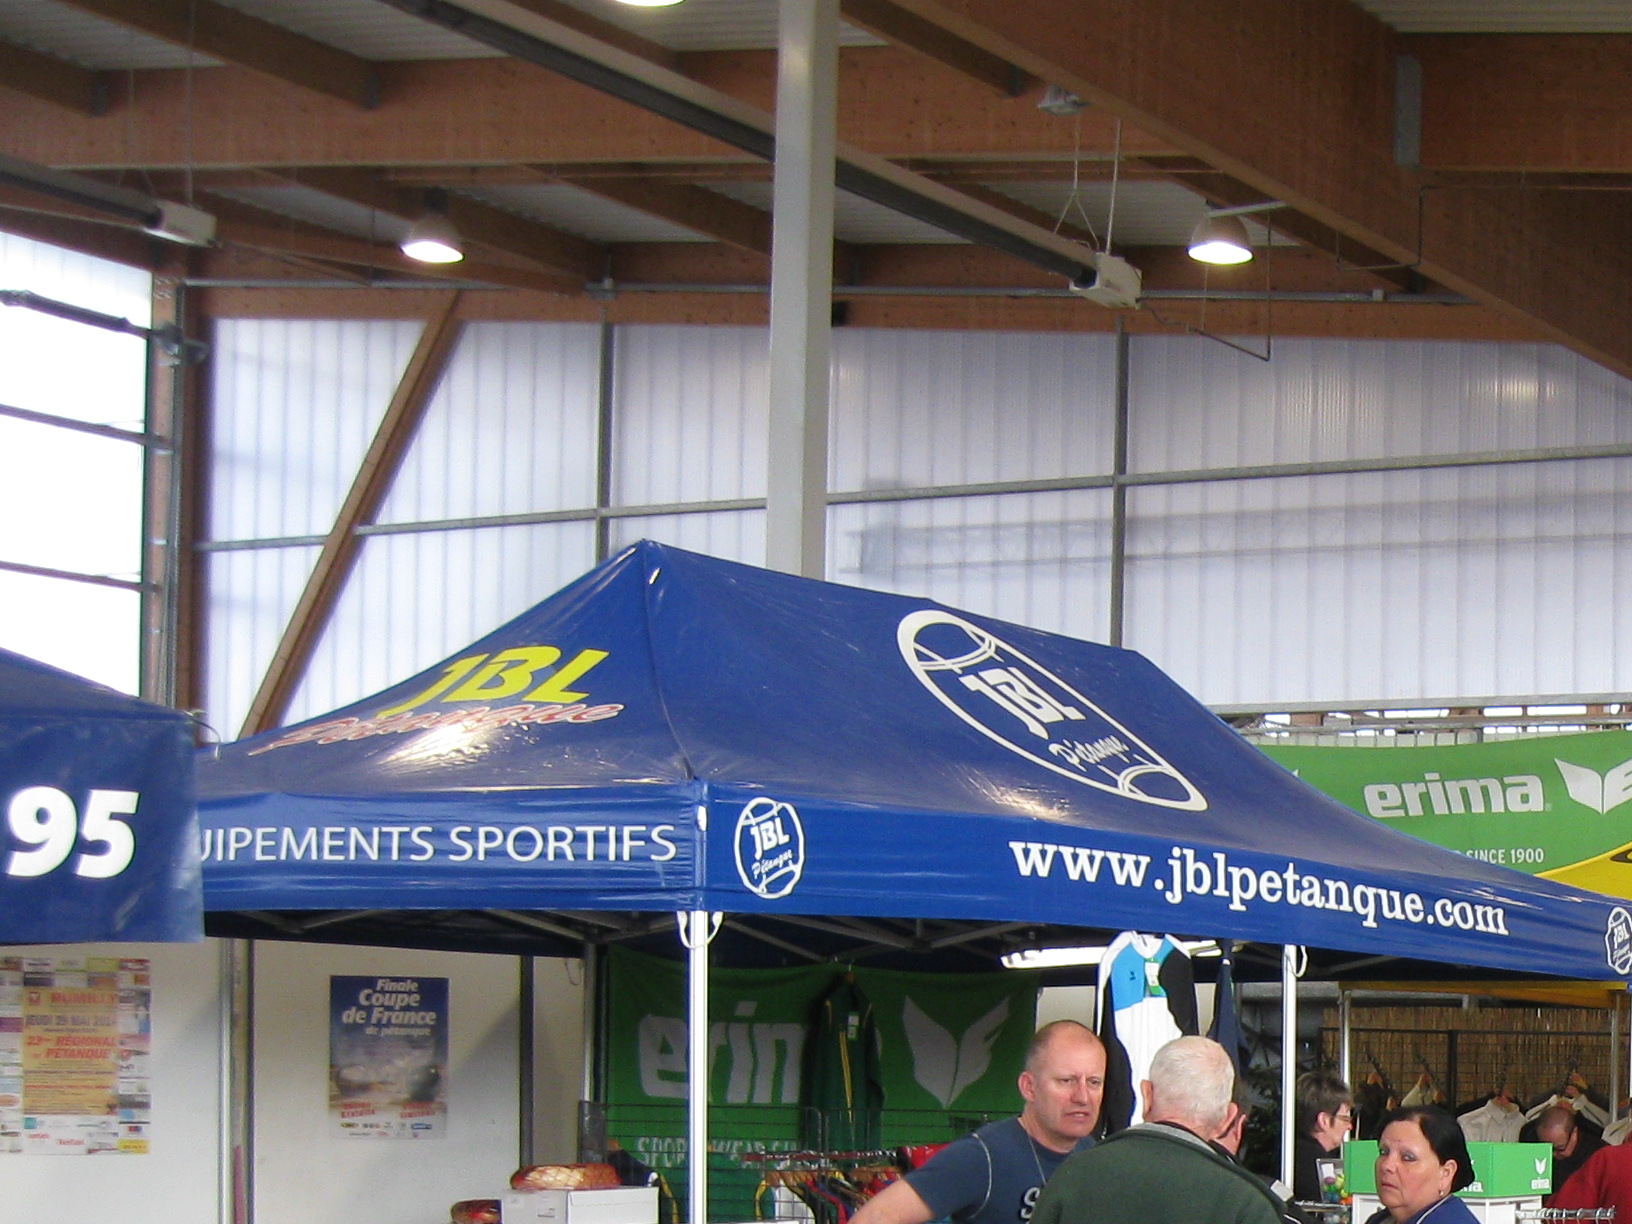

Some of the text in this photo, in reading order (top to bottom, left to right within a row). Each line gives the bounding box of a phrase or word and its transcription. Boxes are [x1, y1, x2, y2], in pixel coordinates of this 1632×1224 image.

[376, 646, 610, 718] JBL
[958, 667, 1087, 741] JBL
[1364, 772, 1545, 819] erima
[8, 785, 140, 879] 95
[448, 824, 678, 862] SPORTIFS
[750, 816, 790, 861] JBL
[1466, 848, 1545, 864] SINCE 1900
[1008, 841, 1510, 937] www.jblpetanque.com
[342, 1006, 436, 1025] de France
[359, 988, 421, 1010] Coupe
[638, 1001, 882, 1104] erim
